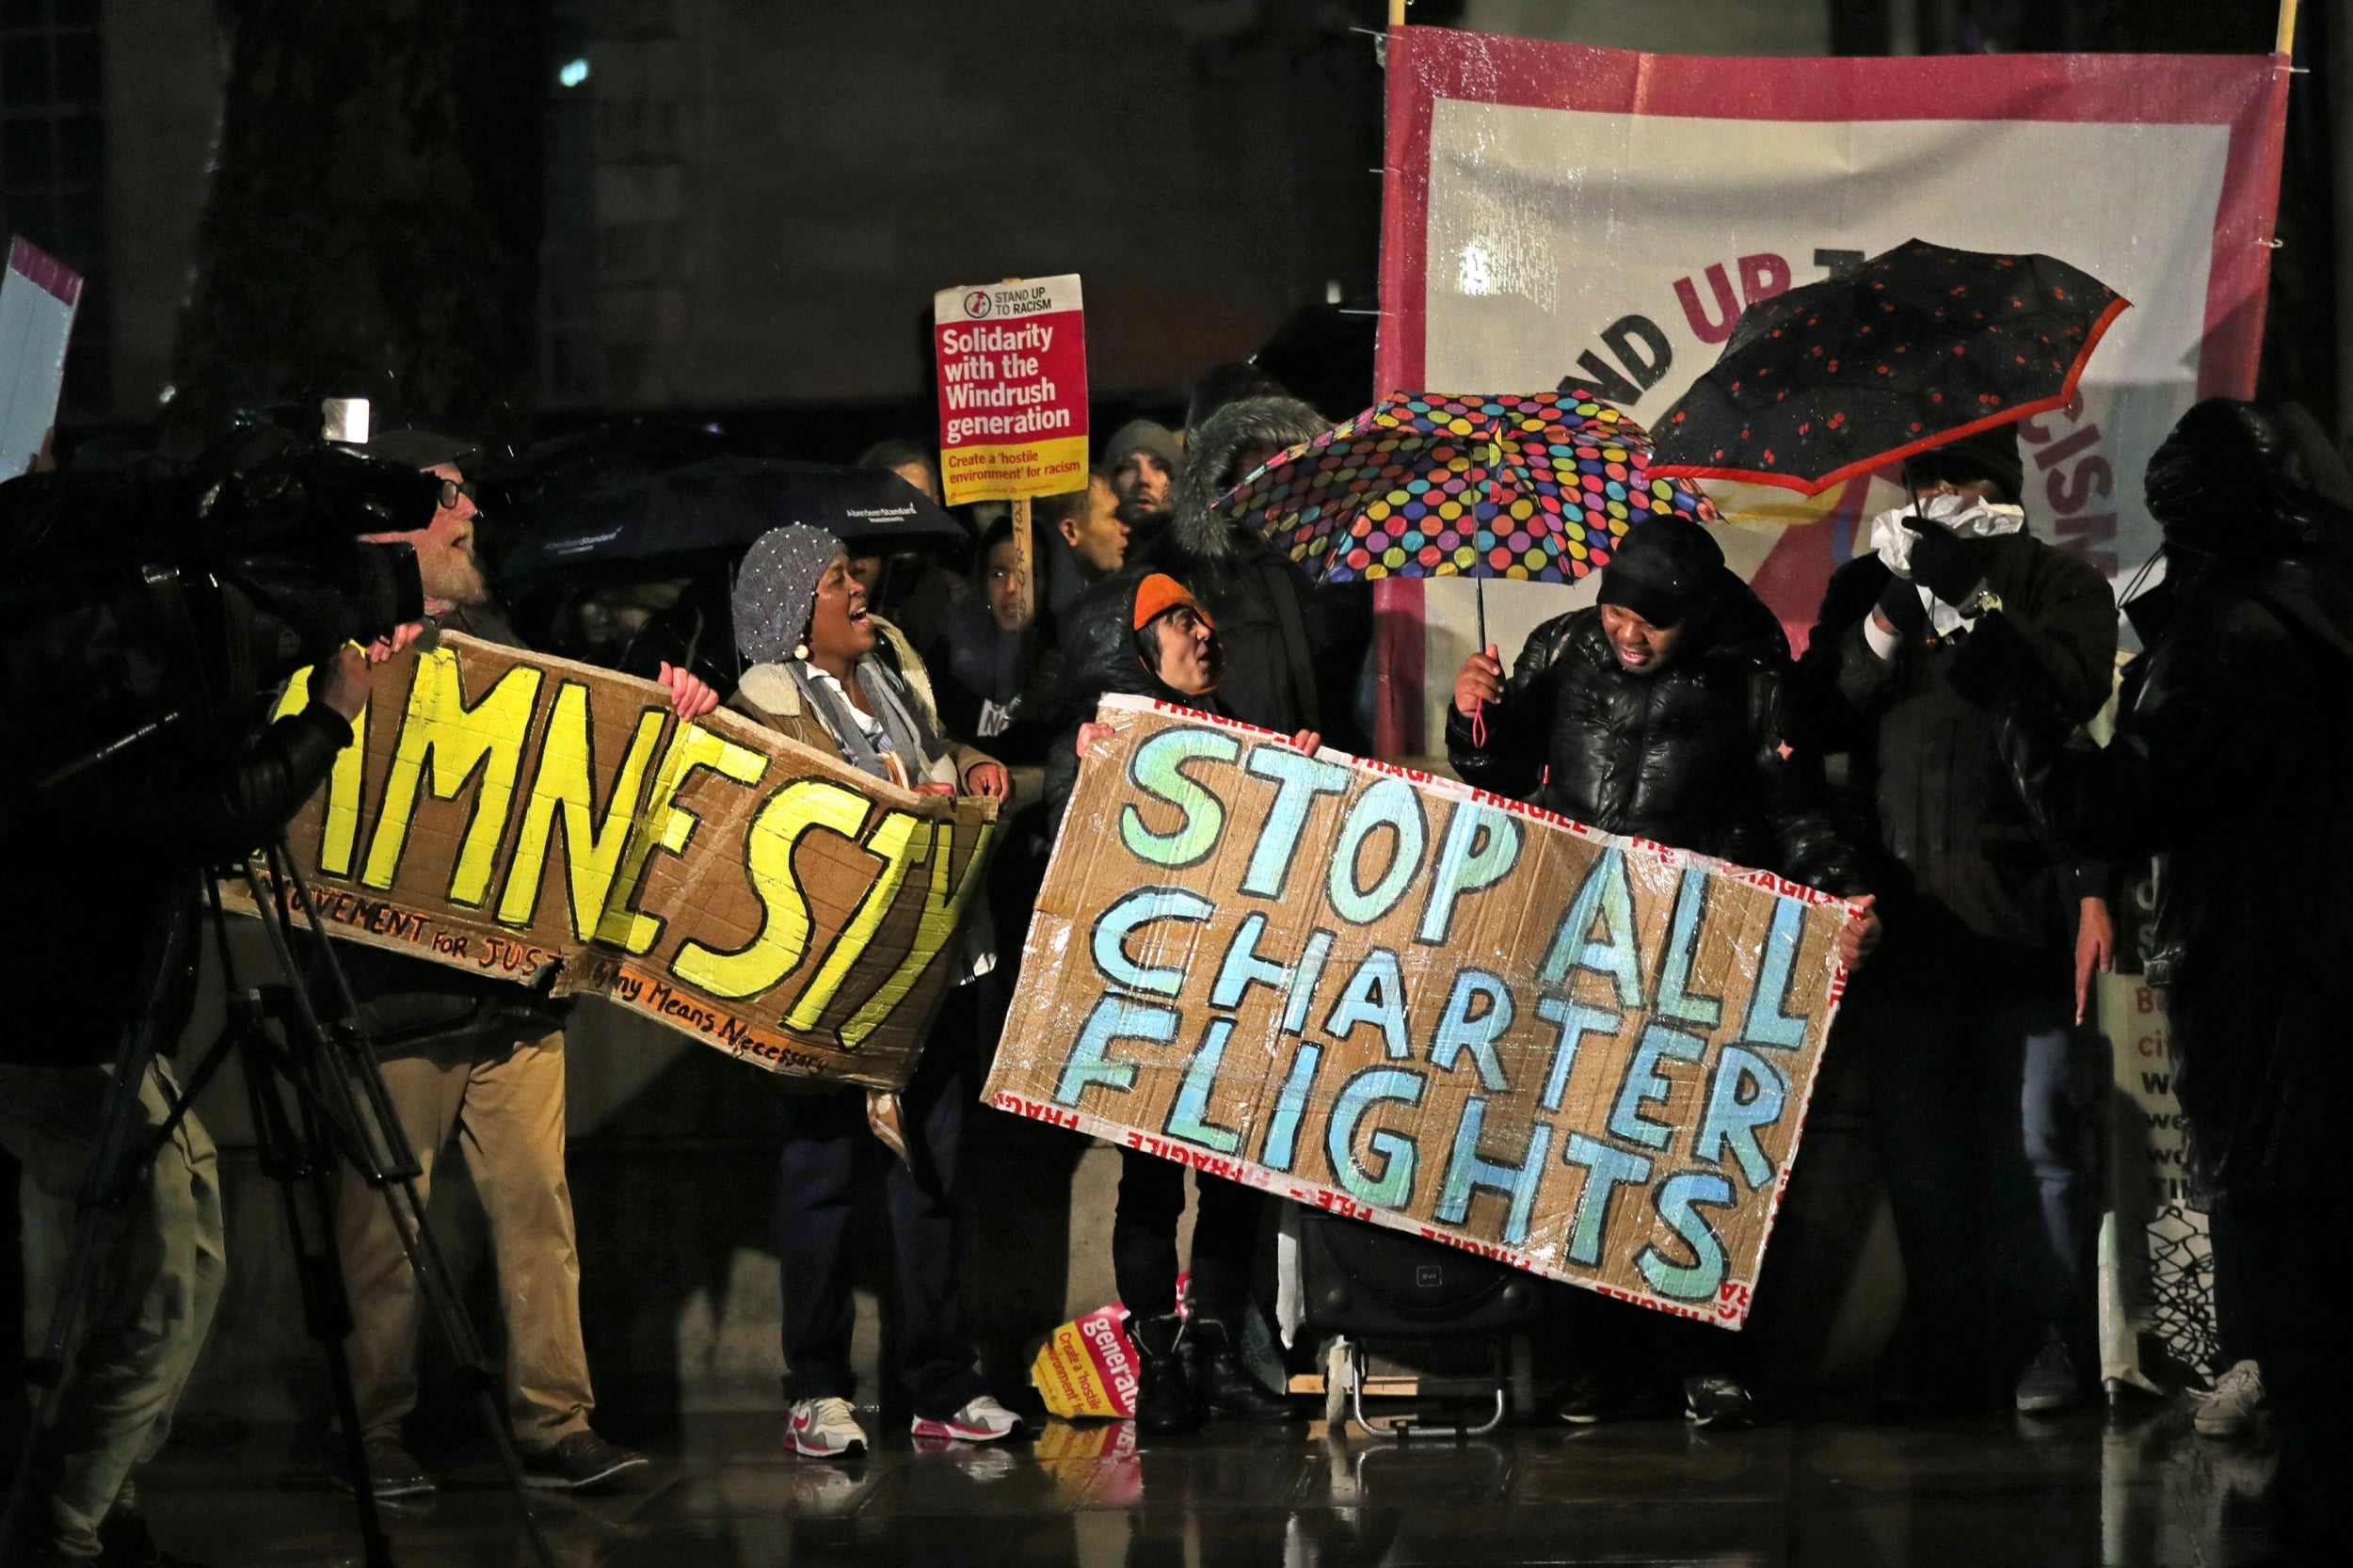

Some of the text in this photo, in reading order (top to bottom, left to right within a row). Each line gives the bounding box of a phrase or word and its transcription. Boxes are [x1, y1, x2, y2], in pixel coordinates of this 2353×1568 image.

[995, 287, 1046, 304] STAND UP
[996, 299, 1052, 315] TO RACISM
[1673, 252, 1792, 344] UP
[943, 324, 1053, 355] Solidarity
[944, 353, 1039, 383] with the
[946, 376, 1056, 410] Windrush
[946, 406, 1070, 444] generation
[949, 453, 985, 469] Create
[988, 456, 996, 464] a
[1027, 468, 1041, 479] for
[1044, 460, 1080, 475] racism
[1470, 787, 1589, 836] FRAGILE
[1119, 724, 1811, 1051] STOP ALL
[431, 931, 468, 958] FOR
[648, 984, 717, 1032] Means
[1089, 885, 1786, 1192] CHARTER
[1049, 991, 1738, 1304] FLIGHTS
[1059, 1332, 1080, 1364] Create
